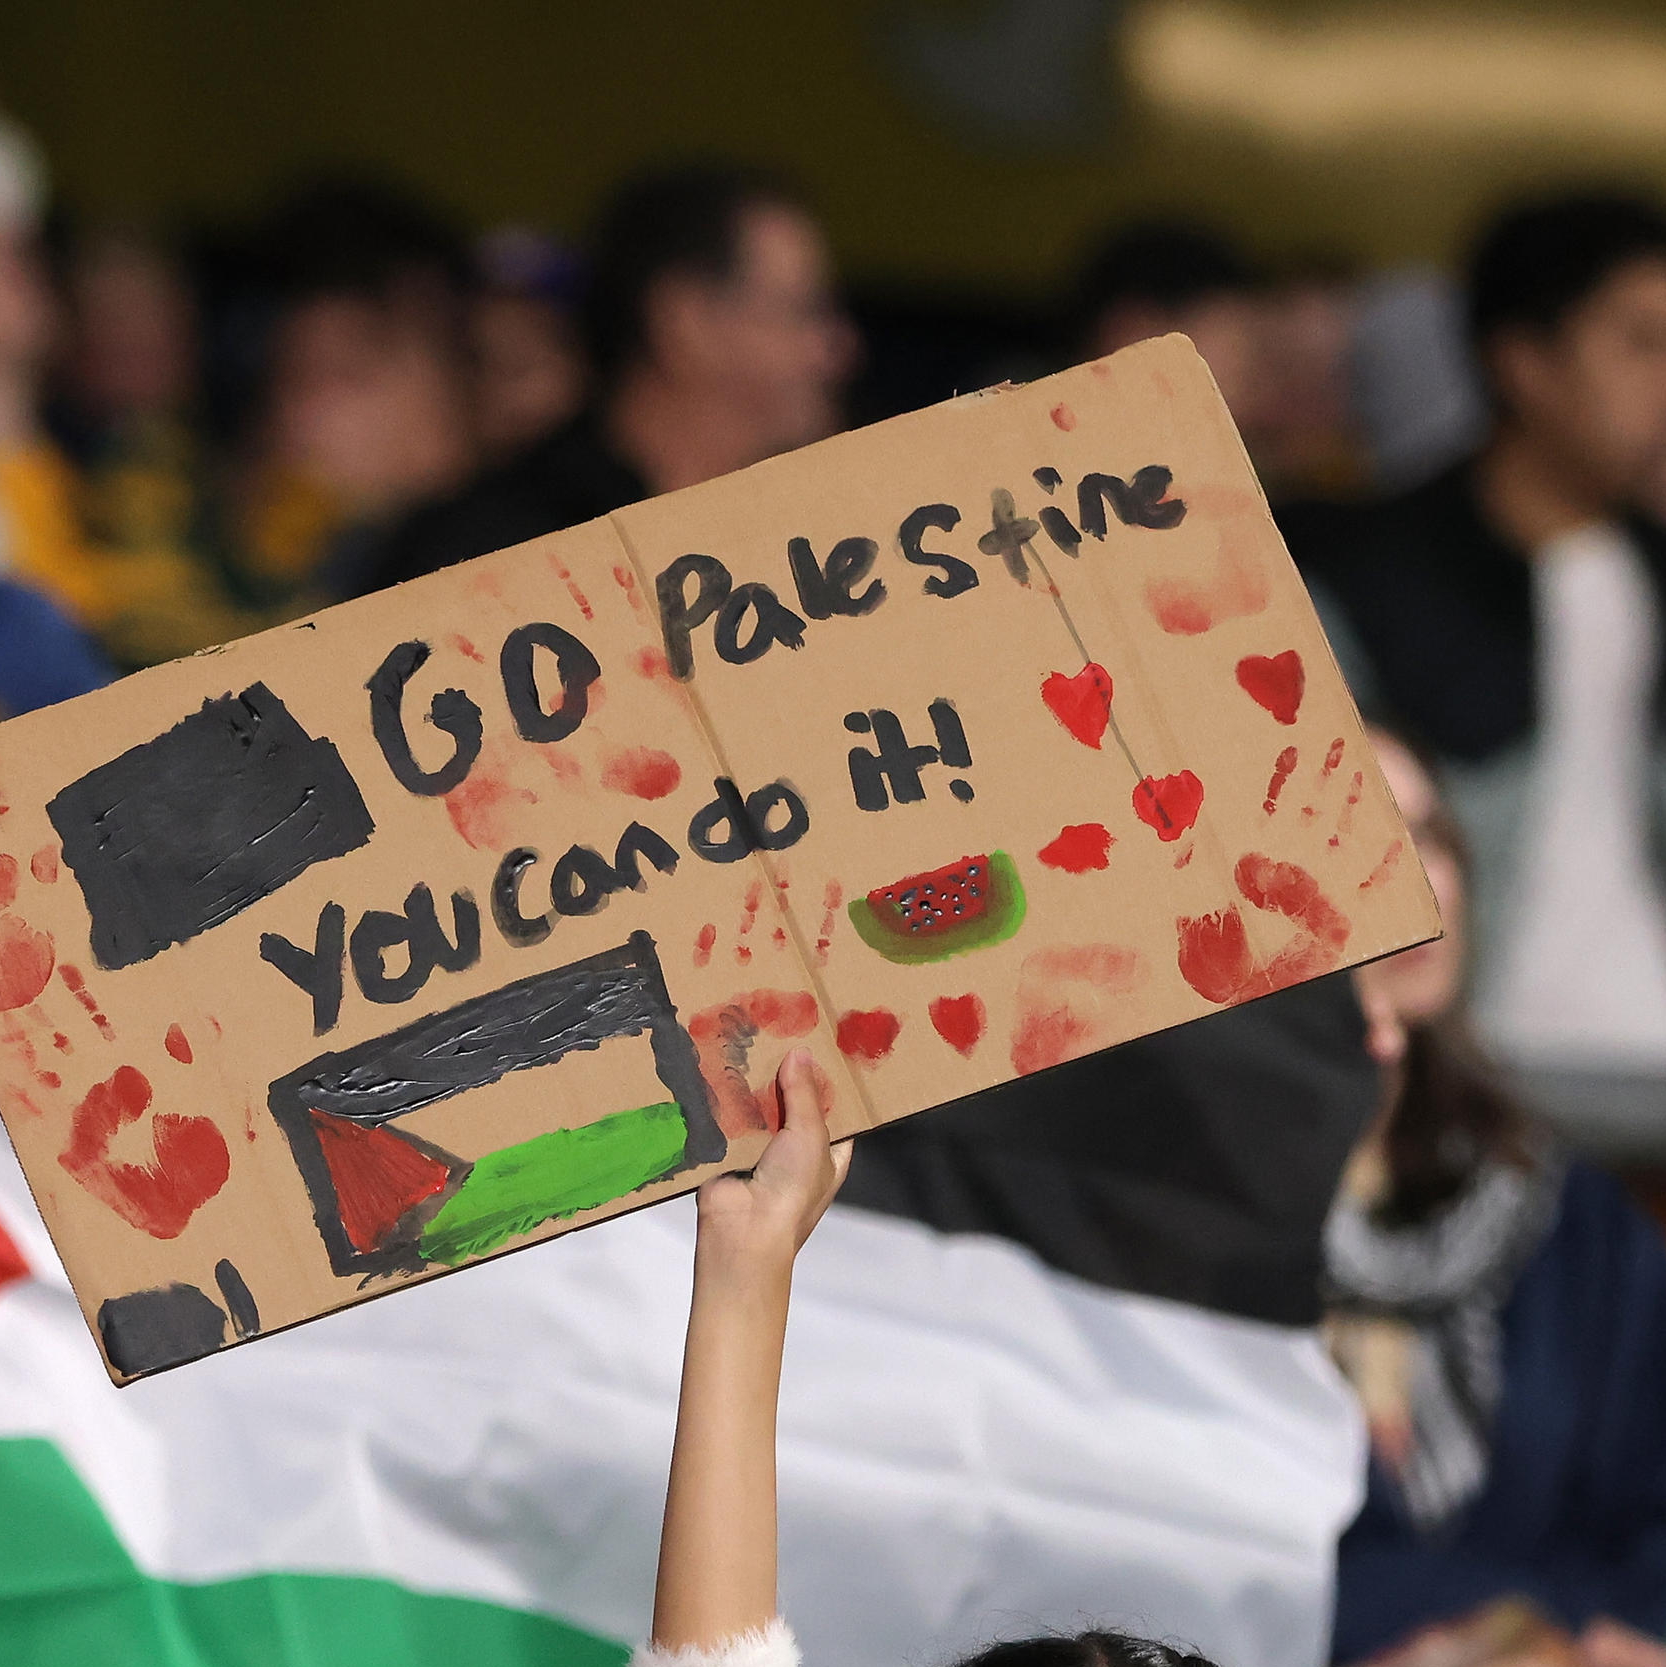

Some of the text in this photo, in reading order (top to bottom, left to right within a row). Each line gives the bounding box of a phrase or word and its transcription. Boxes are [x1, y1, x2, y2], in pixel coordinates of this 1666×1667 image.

[364, 622, 601, 797] GO
[688, 775, 810, 864] do
[843, 696, 974, 812] it!
